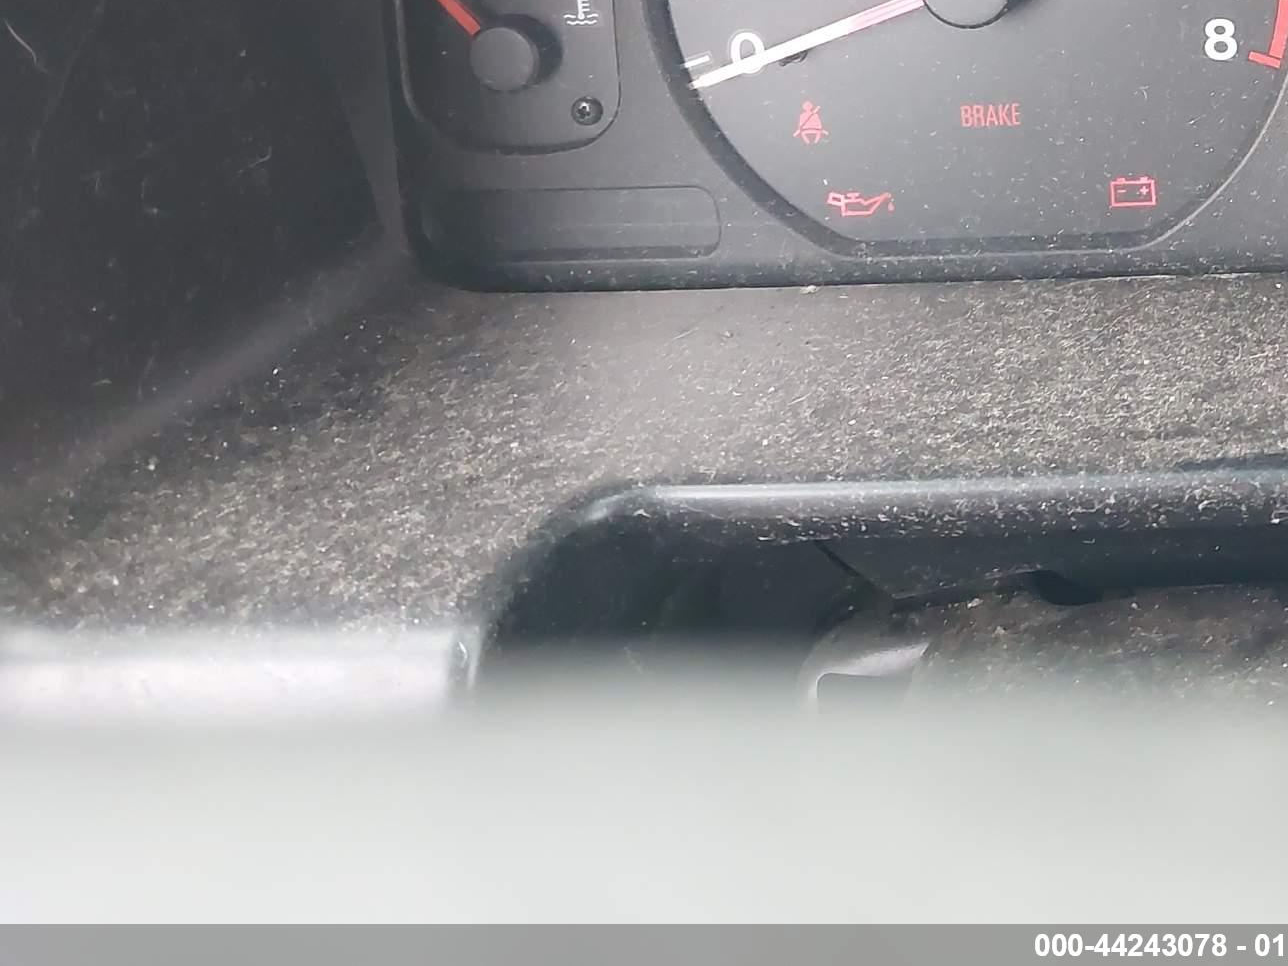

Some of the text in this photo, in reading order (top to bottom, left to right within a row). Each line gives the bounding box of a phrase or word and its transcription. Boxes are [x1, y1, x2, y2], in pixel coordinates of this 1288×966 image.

[730, 32, 765, 74] 0
[1204, 18, 1238, 61] 8
[960, 103, 1020, 127] BRAKE
